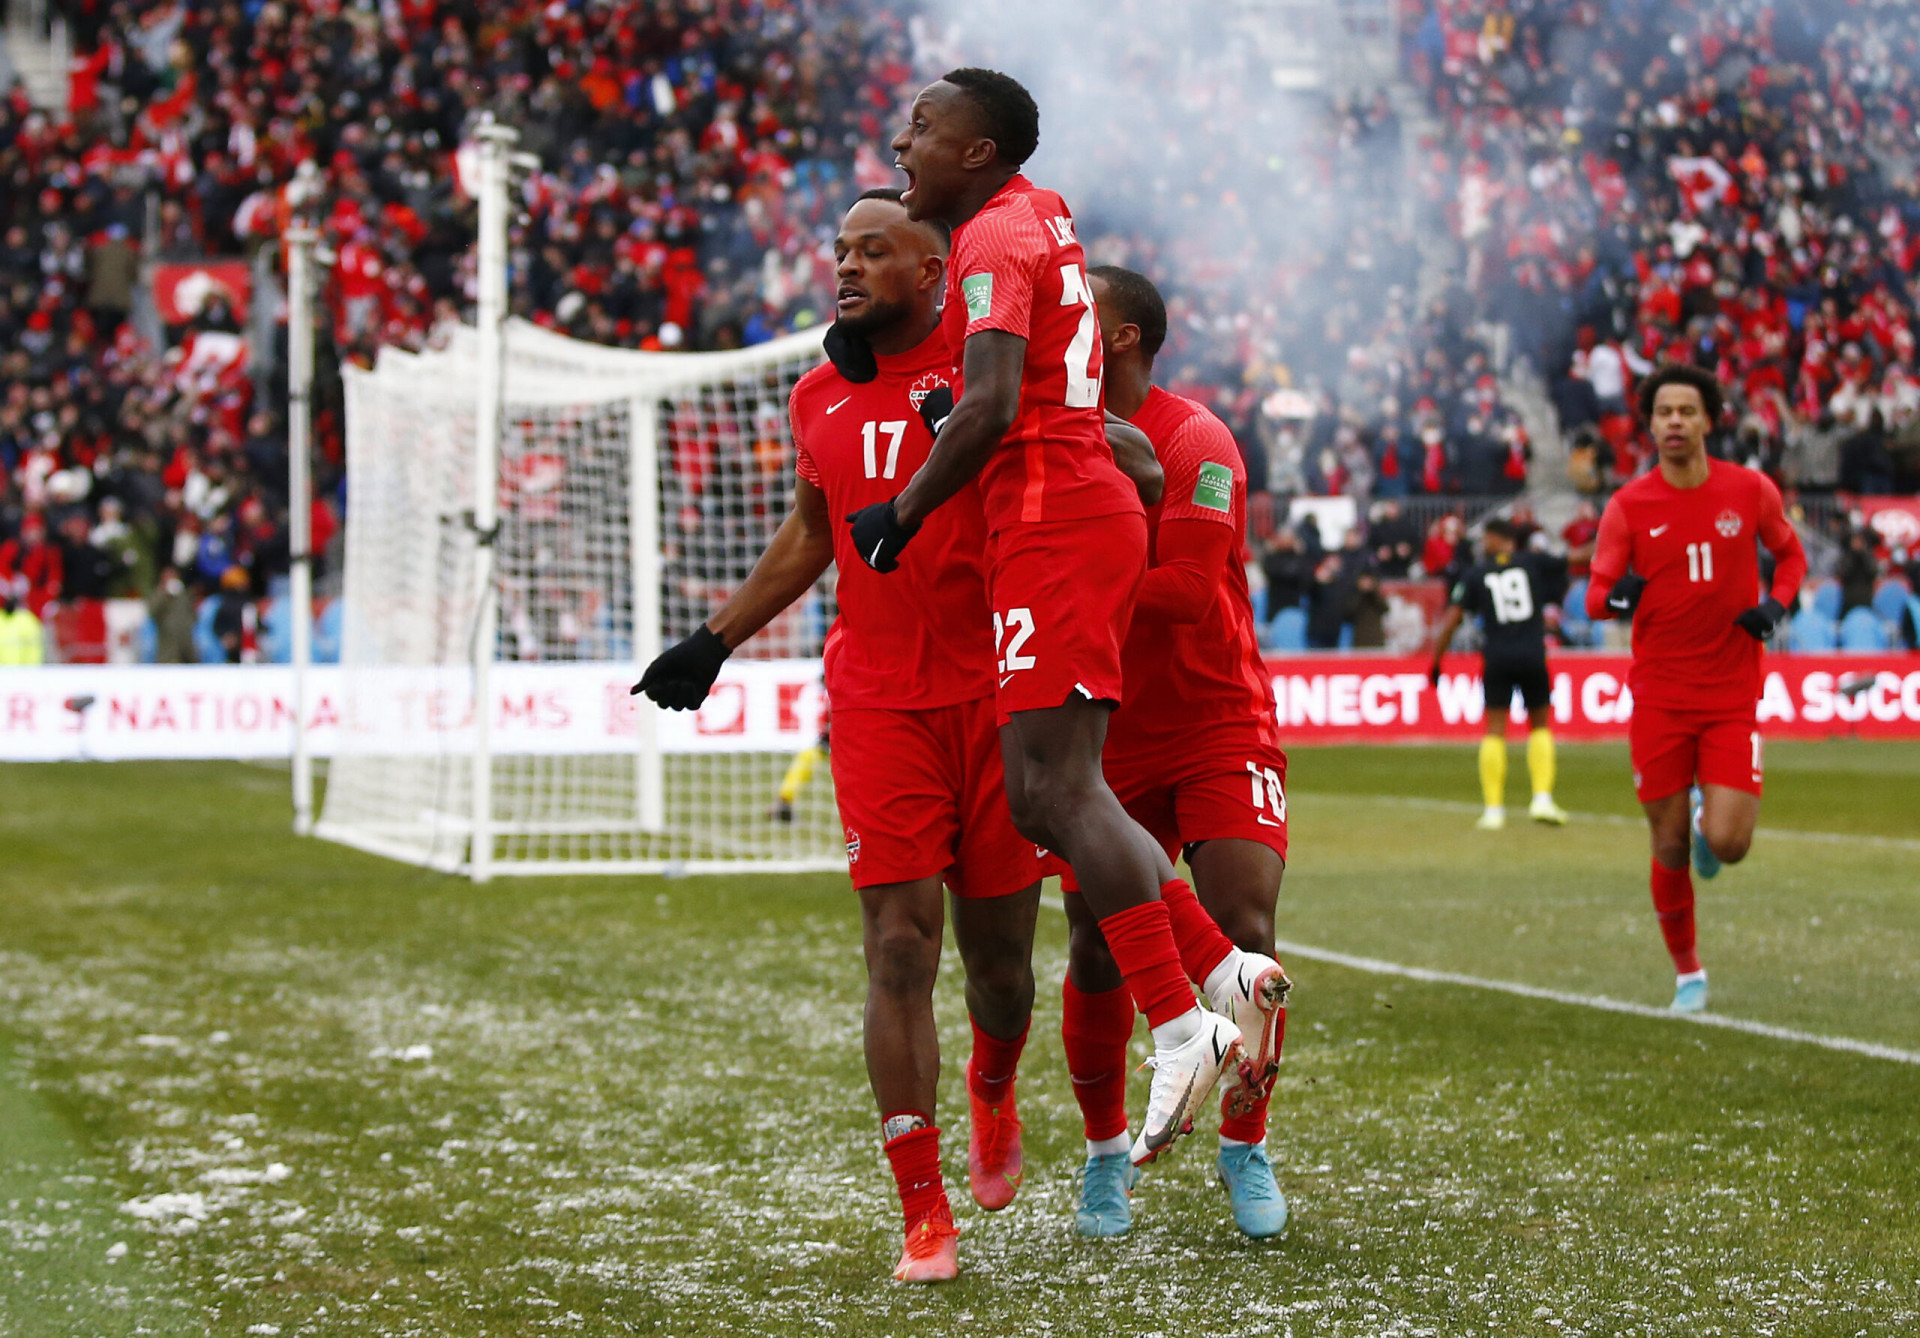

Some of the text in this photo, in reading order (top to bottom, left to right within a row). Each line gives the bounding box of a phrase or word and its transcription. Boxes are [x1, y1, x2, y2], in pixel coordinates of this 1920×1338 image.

[861, 420, 908, 480] 17
[1686, 542, 1713, 582] 11
[1484, 567, 1534, 624] 19
[1246, 760, 1286, 823] 10
